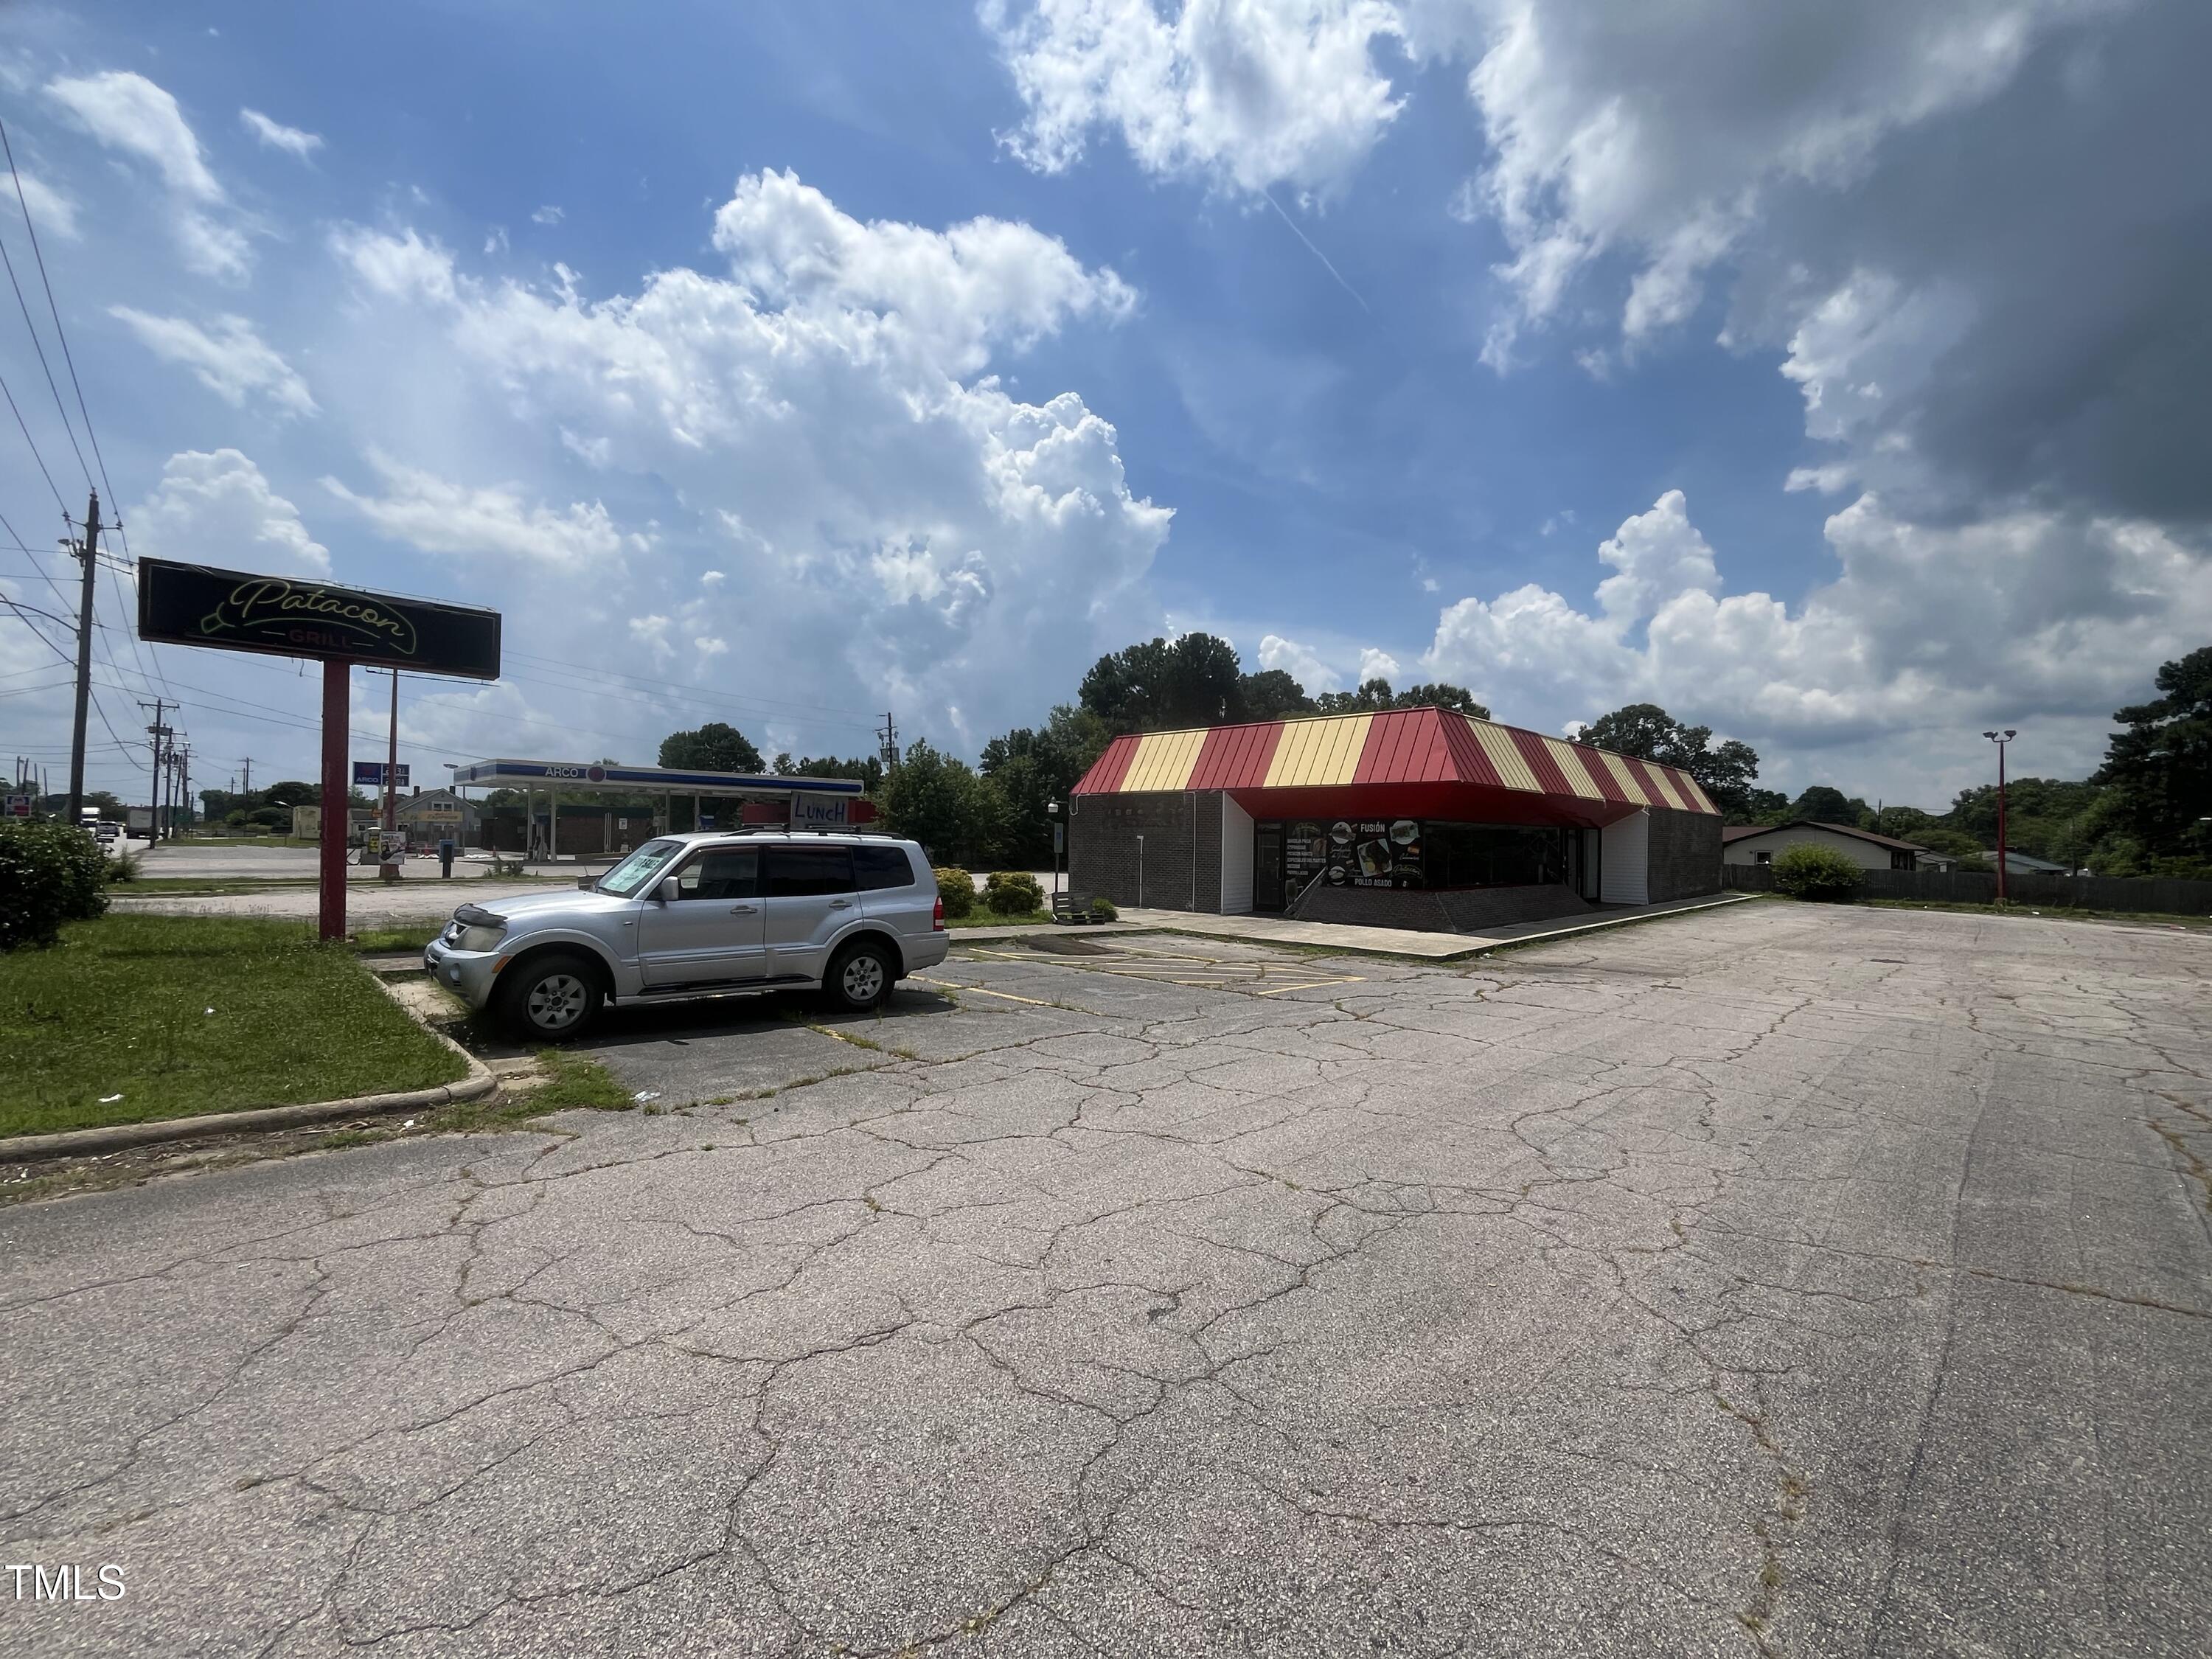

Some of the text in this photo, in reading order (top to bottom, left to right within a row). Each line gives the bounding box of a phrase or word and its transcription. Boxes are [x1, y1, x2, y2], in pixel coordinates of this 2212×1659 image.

[230, 579, 405, 636] Patacon
[289, 629, 352, 648] GRILL
[545, 767, 579, 778] ARCO
[1360, 821, 1385, 832] FUSIÓN
